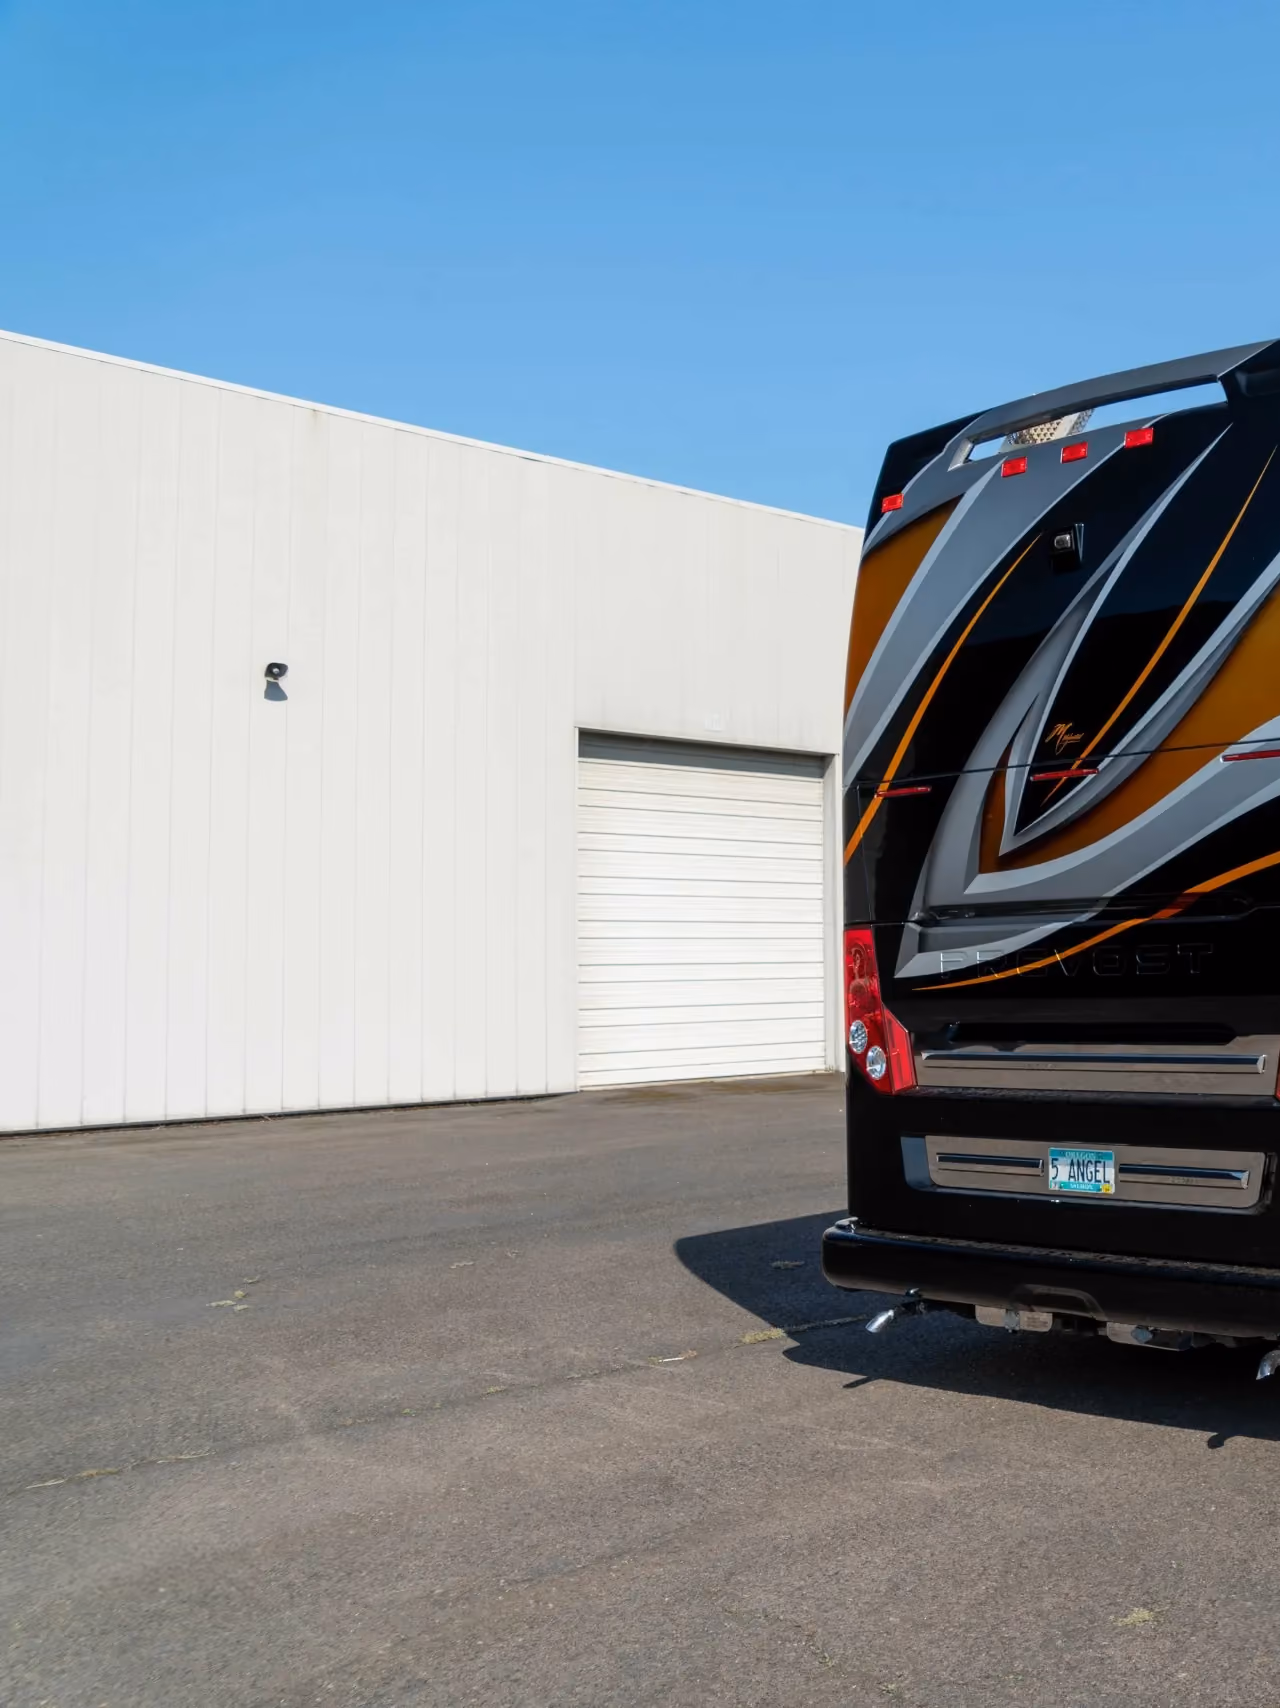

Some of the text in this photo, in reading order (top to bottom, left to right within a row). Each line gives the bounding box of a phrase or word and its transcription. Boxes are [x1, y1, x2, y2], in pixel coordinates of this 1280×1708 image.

[940, 943, 1214, 979] PREVOST
[1052, 1157, 1110, 1183] 5 ANGEL
